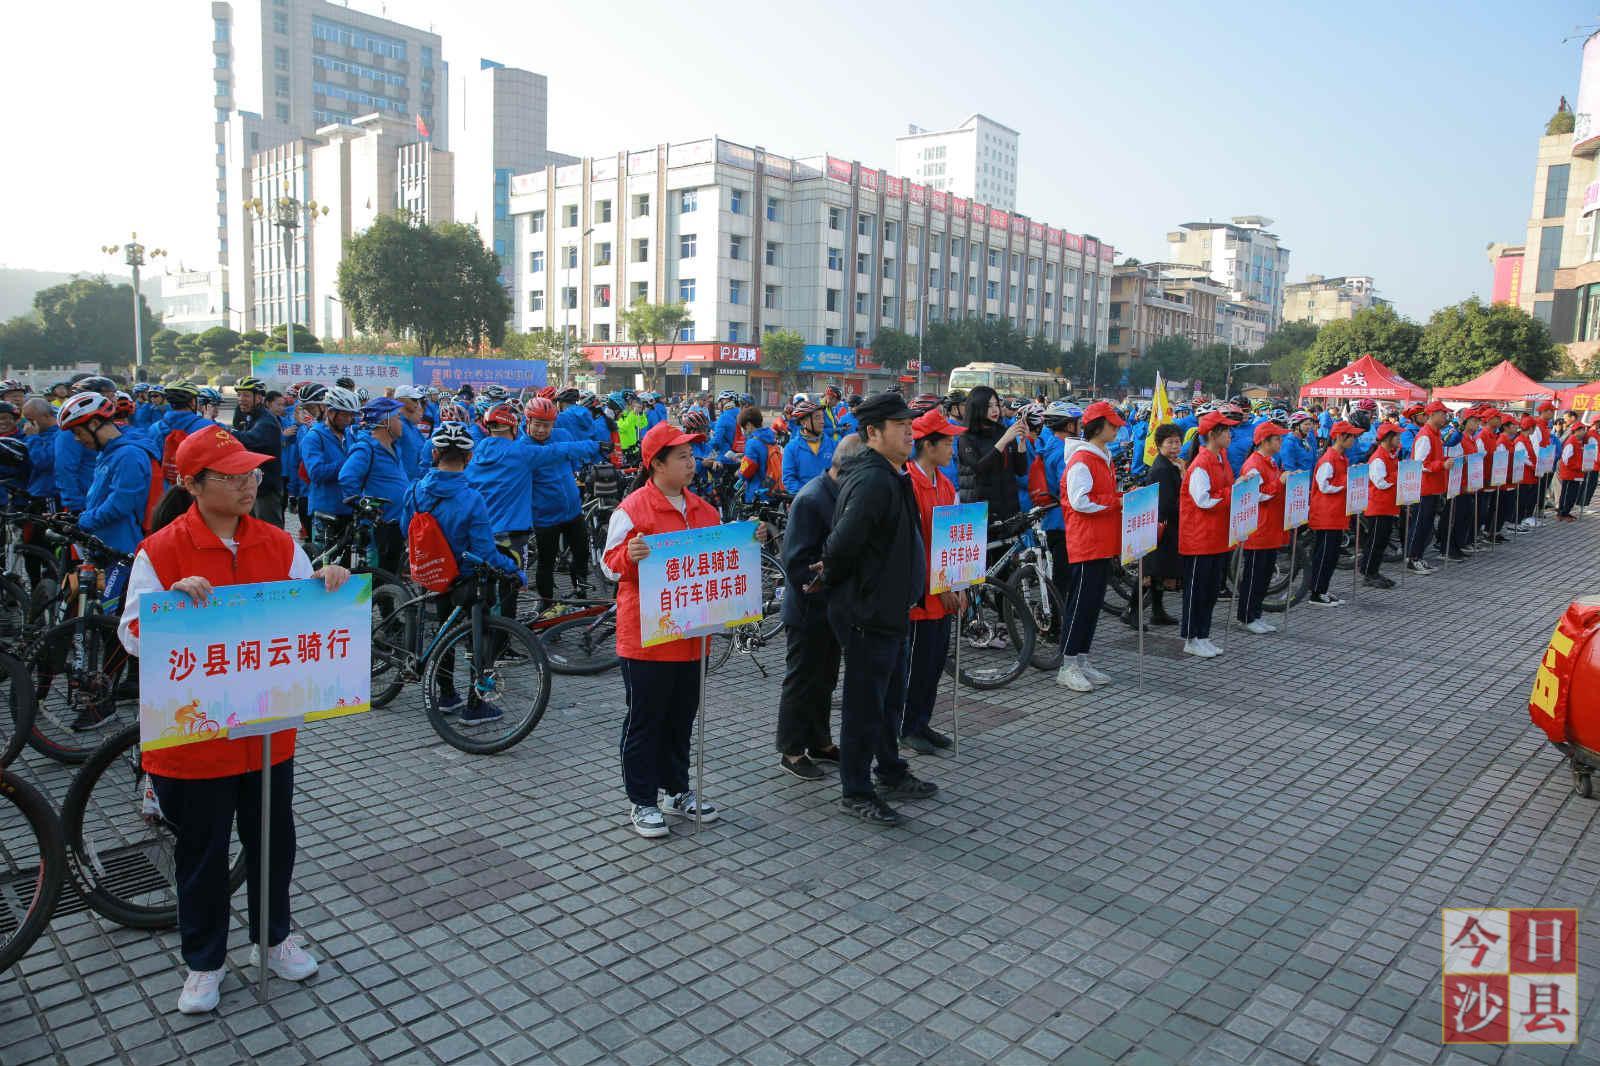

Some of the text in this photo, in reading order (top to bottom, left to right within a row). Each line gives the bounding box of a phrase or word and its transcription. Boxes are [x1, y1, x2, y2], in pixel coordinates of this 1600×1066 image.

[278, 362, 400, 378] 福建省大学生篮球联赛
[665, 548, 739, 582] 德化县骑迹
[941, 544, 980, 566] 自行车协会
[660, 574, 747, 612] 自行车俱乐部
[168, 629, 351, 682] 沙县闲云骑行
